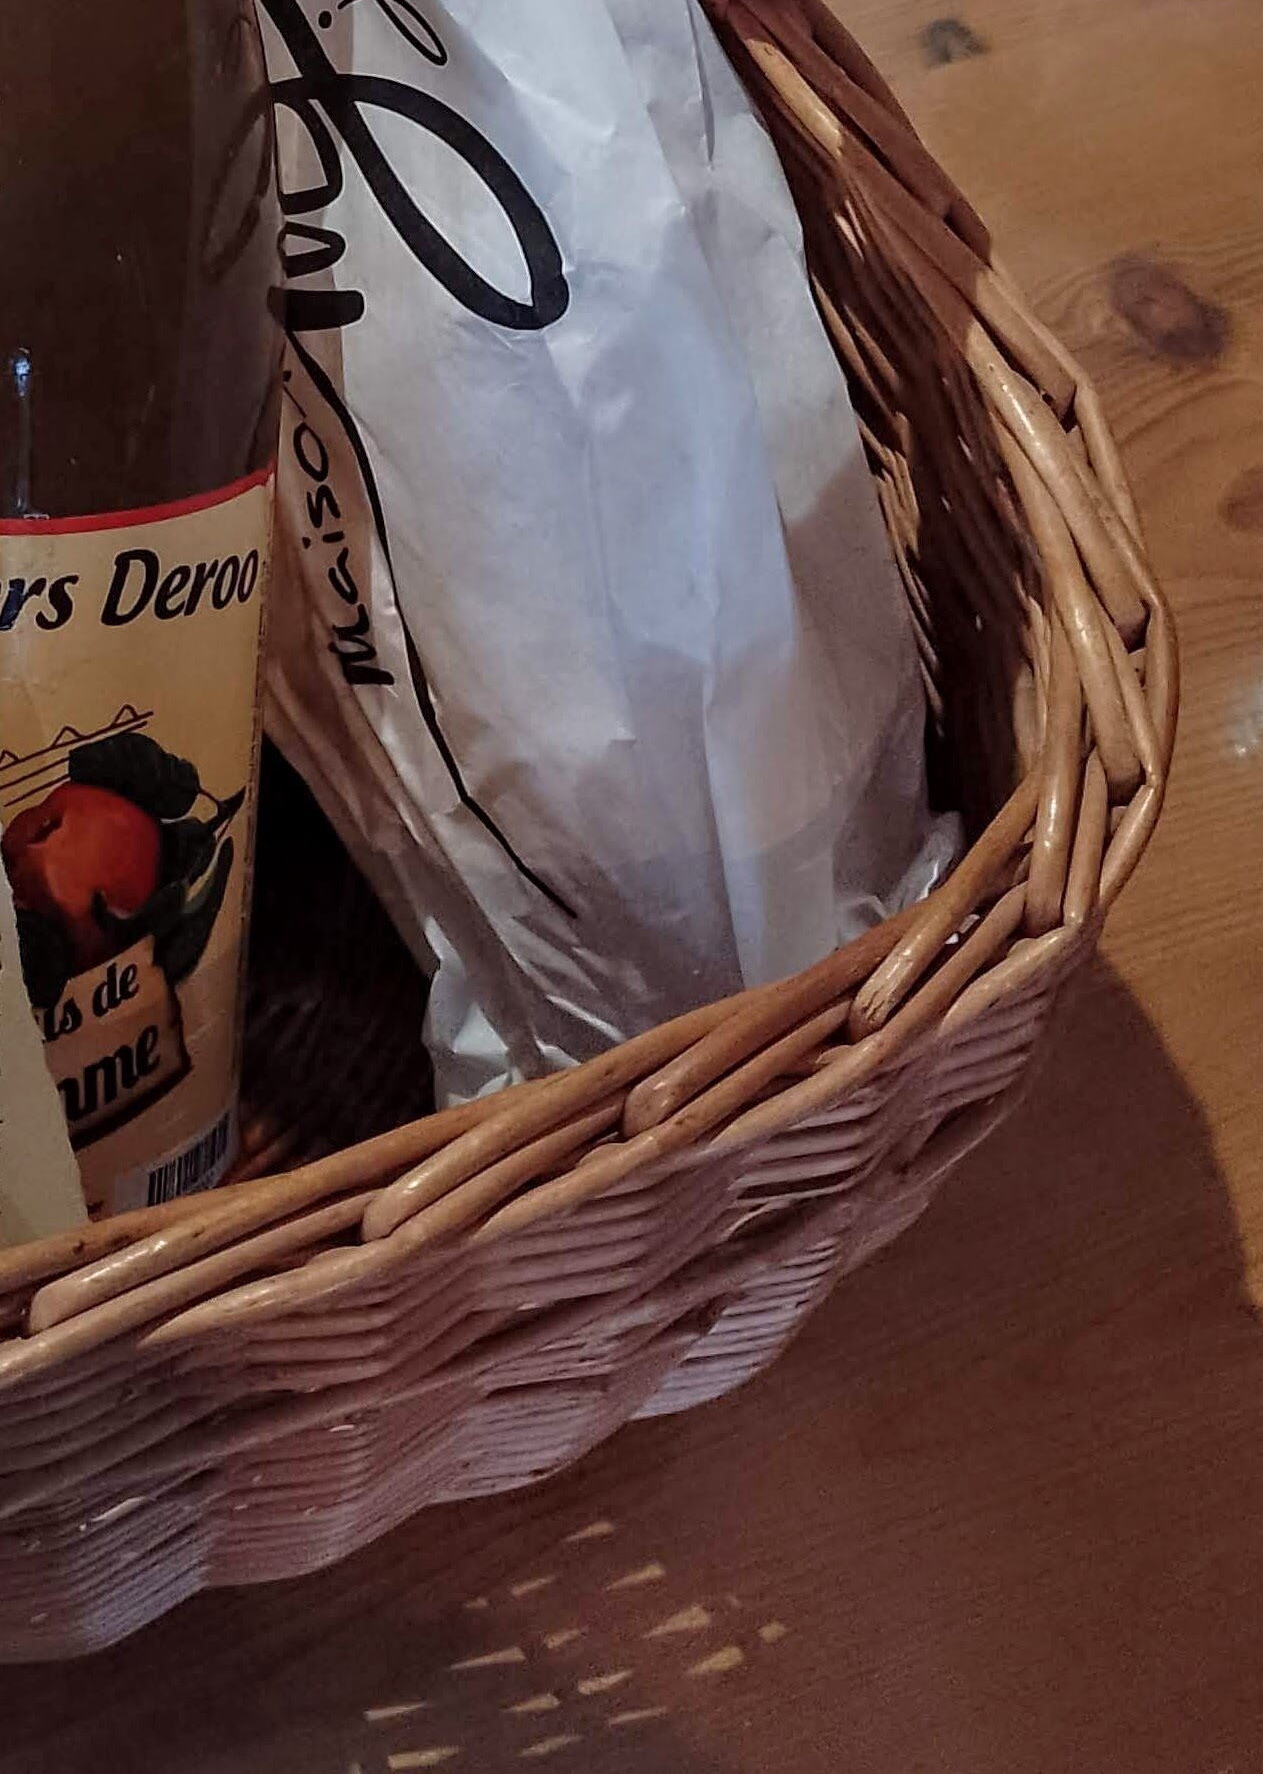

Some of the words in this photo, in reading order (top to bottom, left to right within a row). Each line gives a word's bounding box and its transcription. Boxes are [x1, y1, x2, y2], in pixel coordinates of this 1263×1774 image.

[283, 386, 395, 686] Maiso
[100, 548, 259, 627] Deroo
[92, 962, 140, 1018] de
